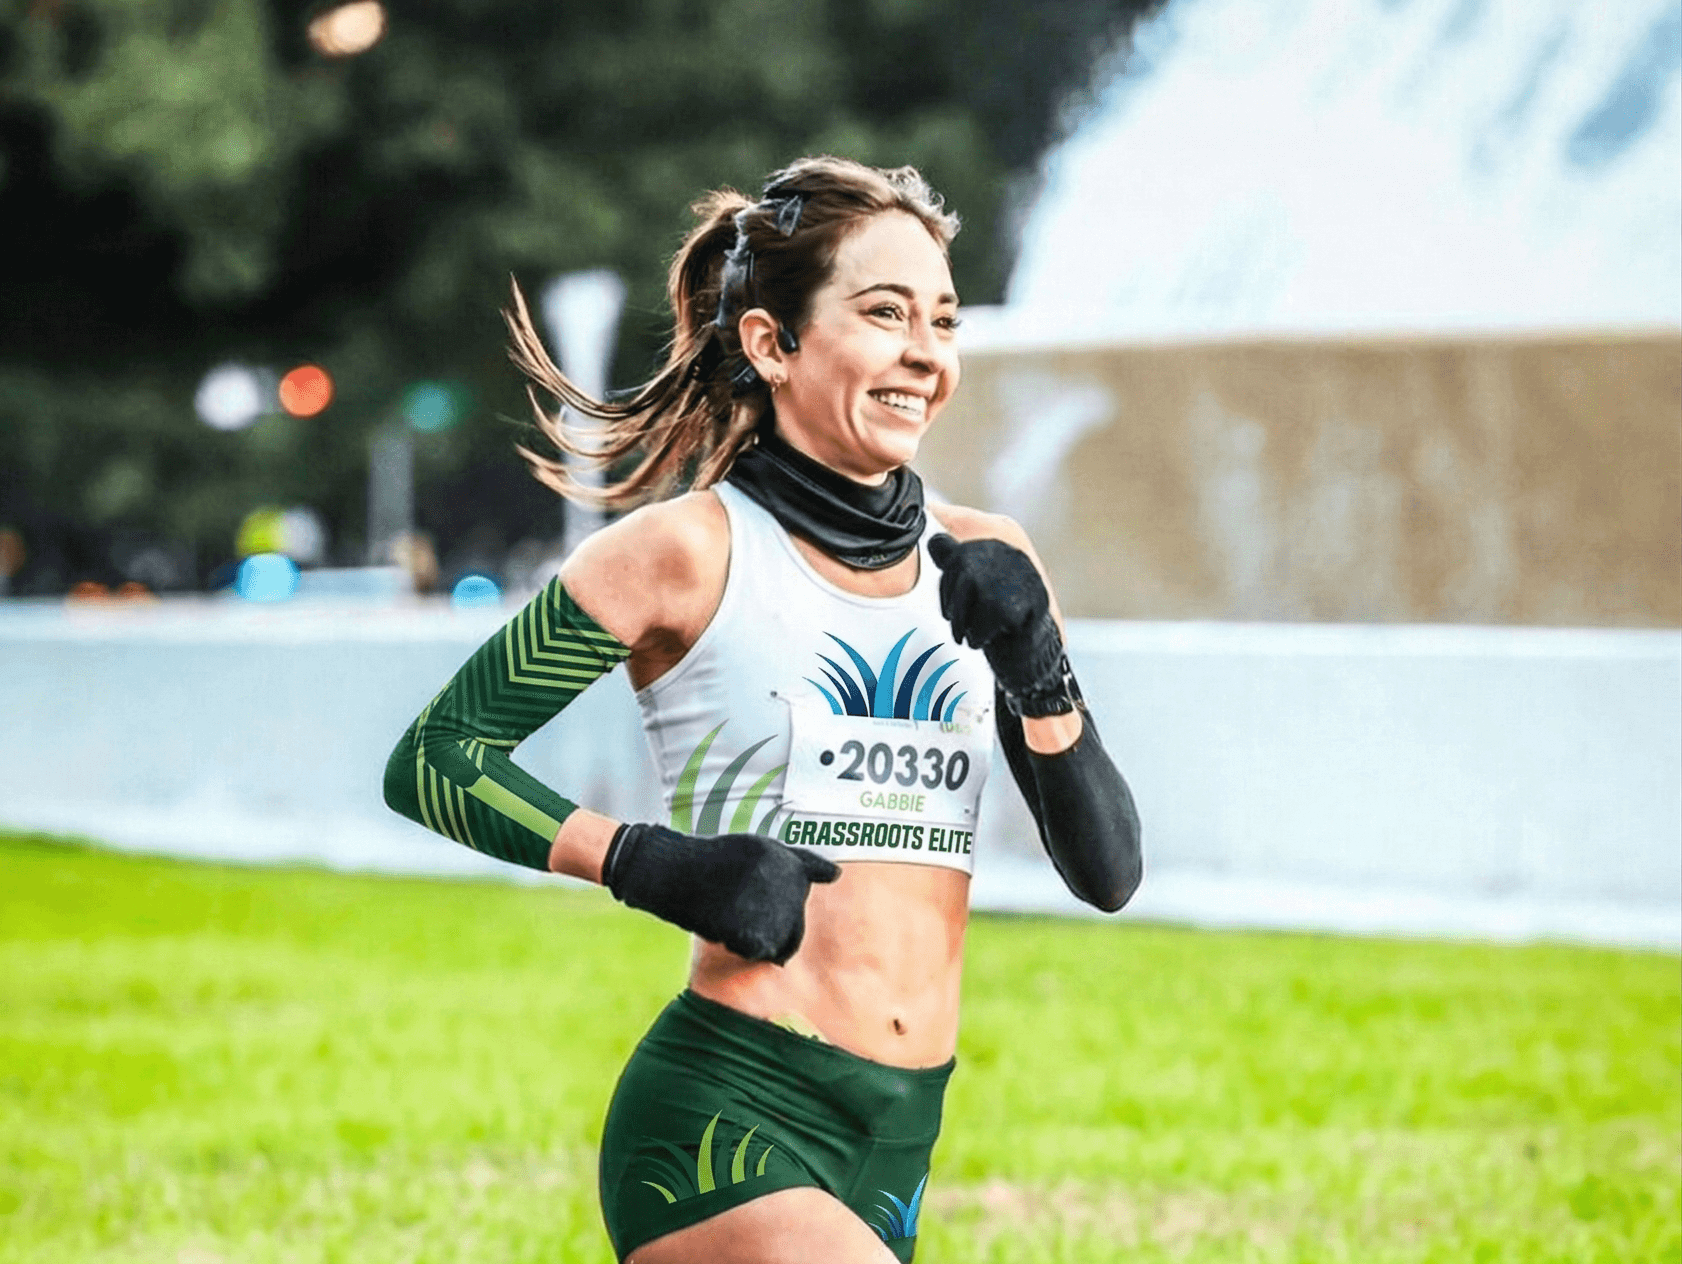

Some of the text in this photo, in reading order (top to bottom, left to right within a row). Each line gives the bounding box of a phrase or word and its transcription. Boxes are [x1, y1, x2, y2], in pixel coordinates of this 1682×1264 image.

[860, 791, 926, 812] GABBIE
[784, 820, 973, 854] GRASSROOTS ELITE
